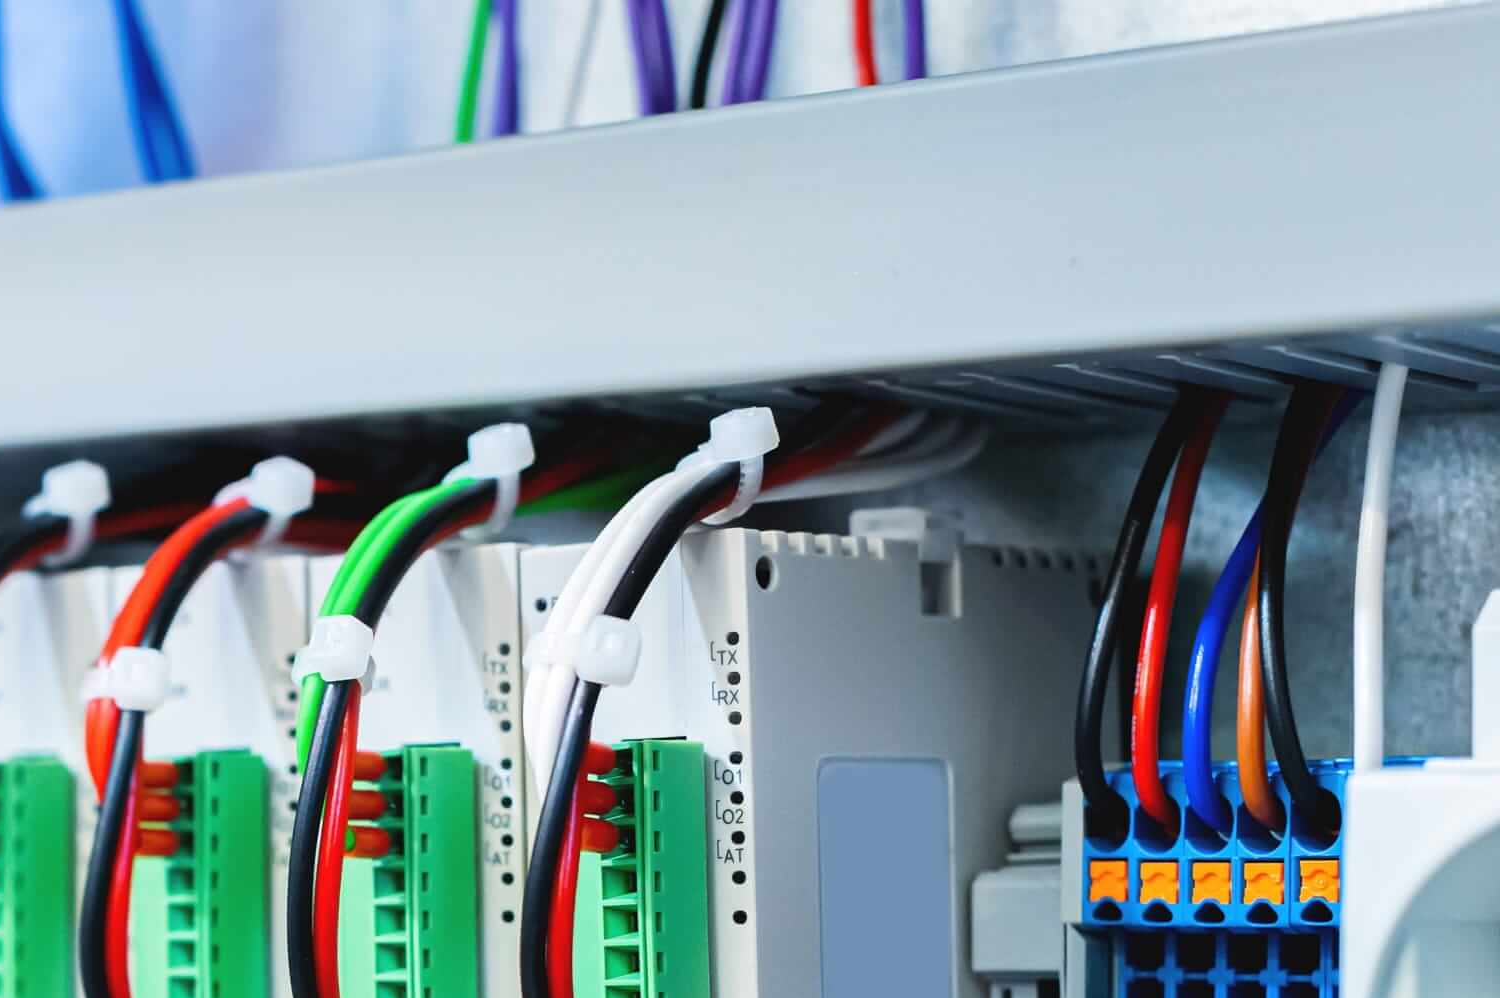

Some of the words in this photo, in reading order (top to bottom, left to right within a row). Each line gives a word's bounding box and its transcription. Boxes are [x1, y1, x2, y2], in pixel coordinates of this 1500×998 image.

[716, 650, 739, 665] TX
[717, 690, 740, 705] RX
[724, 848, 745, 864] AT
